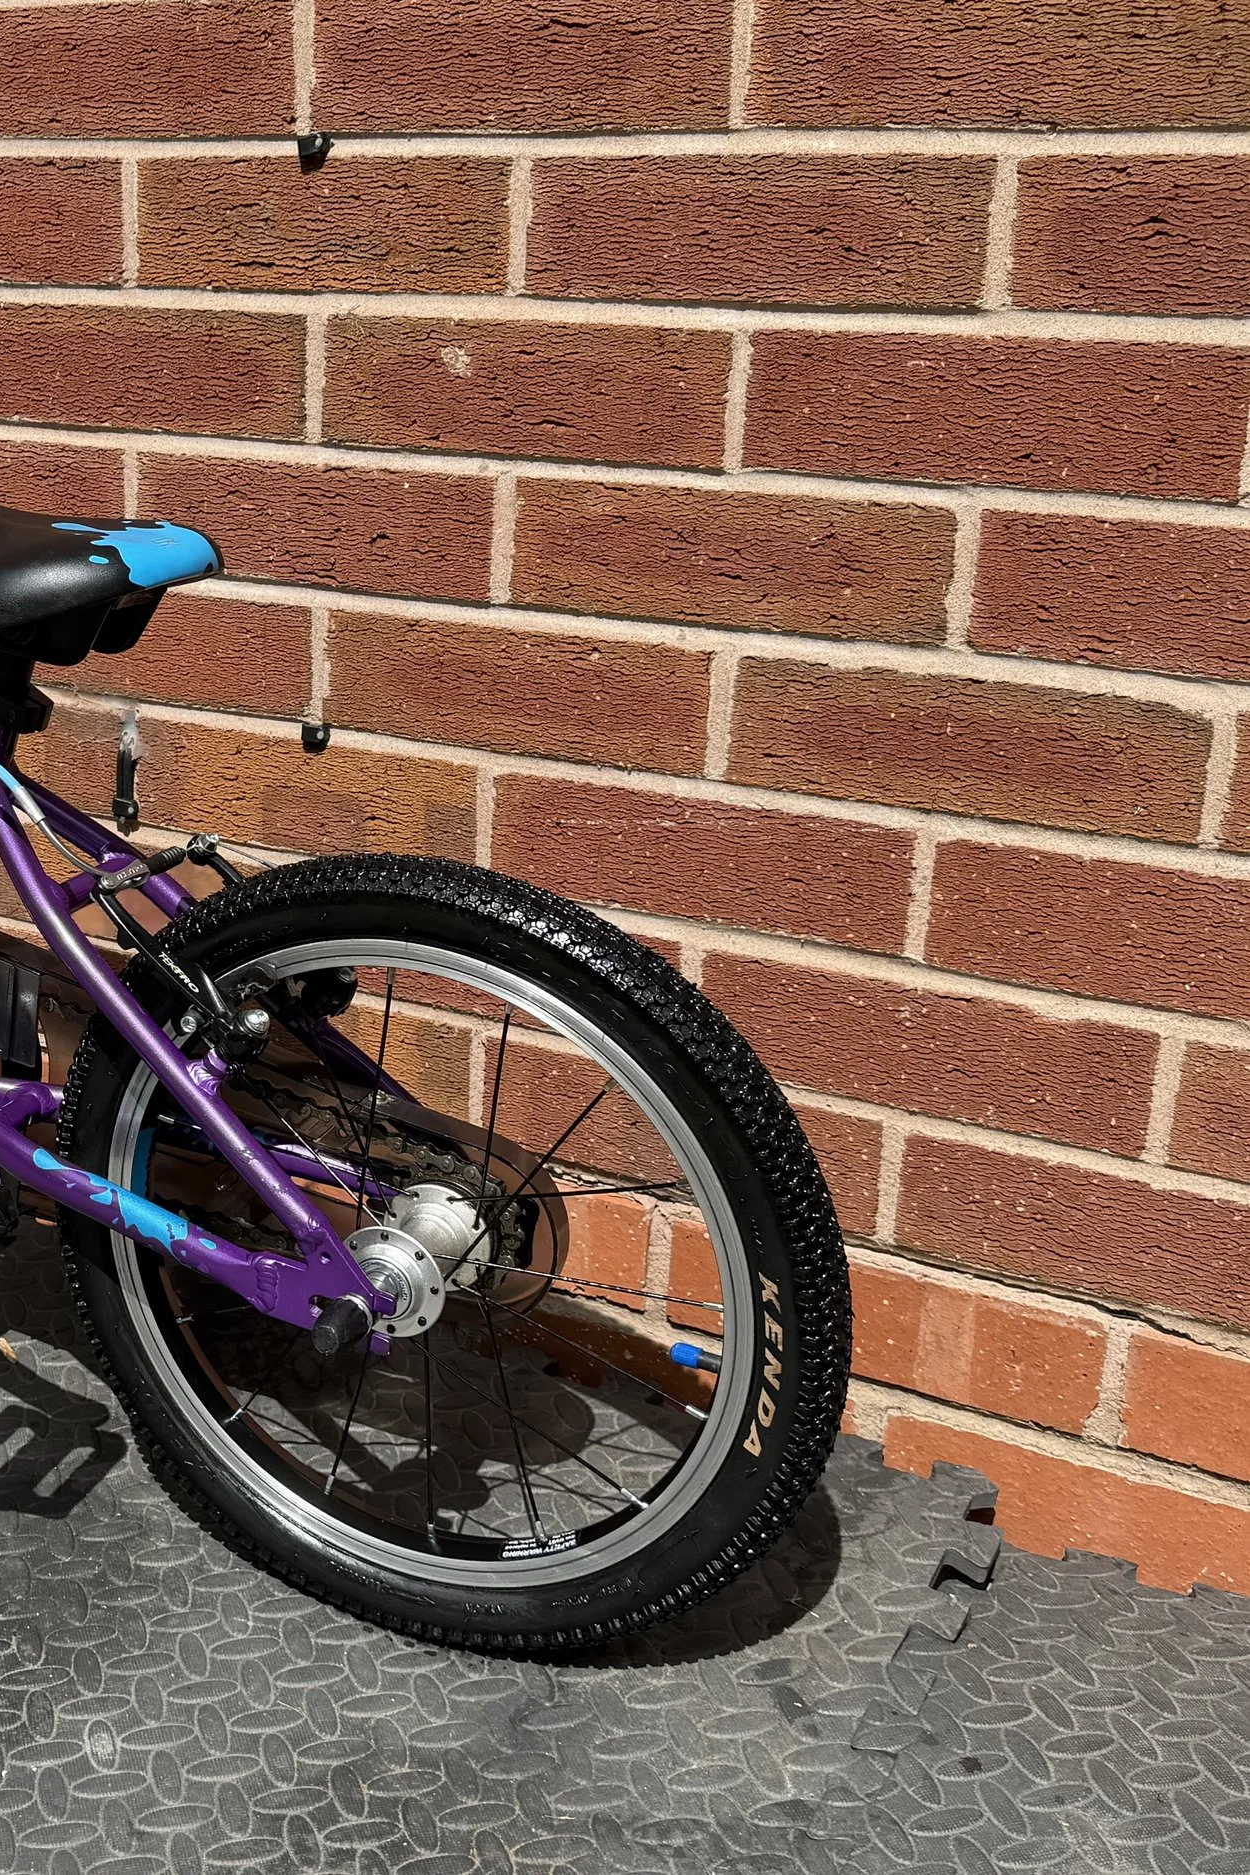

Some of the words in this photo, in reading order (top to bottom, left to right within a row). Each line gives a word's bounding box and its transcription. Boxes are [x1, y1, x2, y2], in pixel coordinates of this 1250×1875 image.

[158, 951, 200, 993] TEKTRO
[743, 1271, 784, 1457] KENDA
[502, 1547, 543, 1558] WARNING
[543, 1539, 577, 1553] SAFETY
